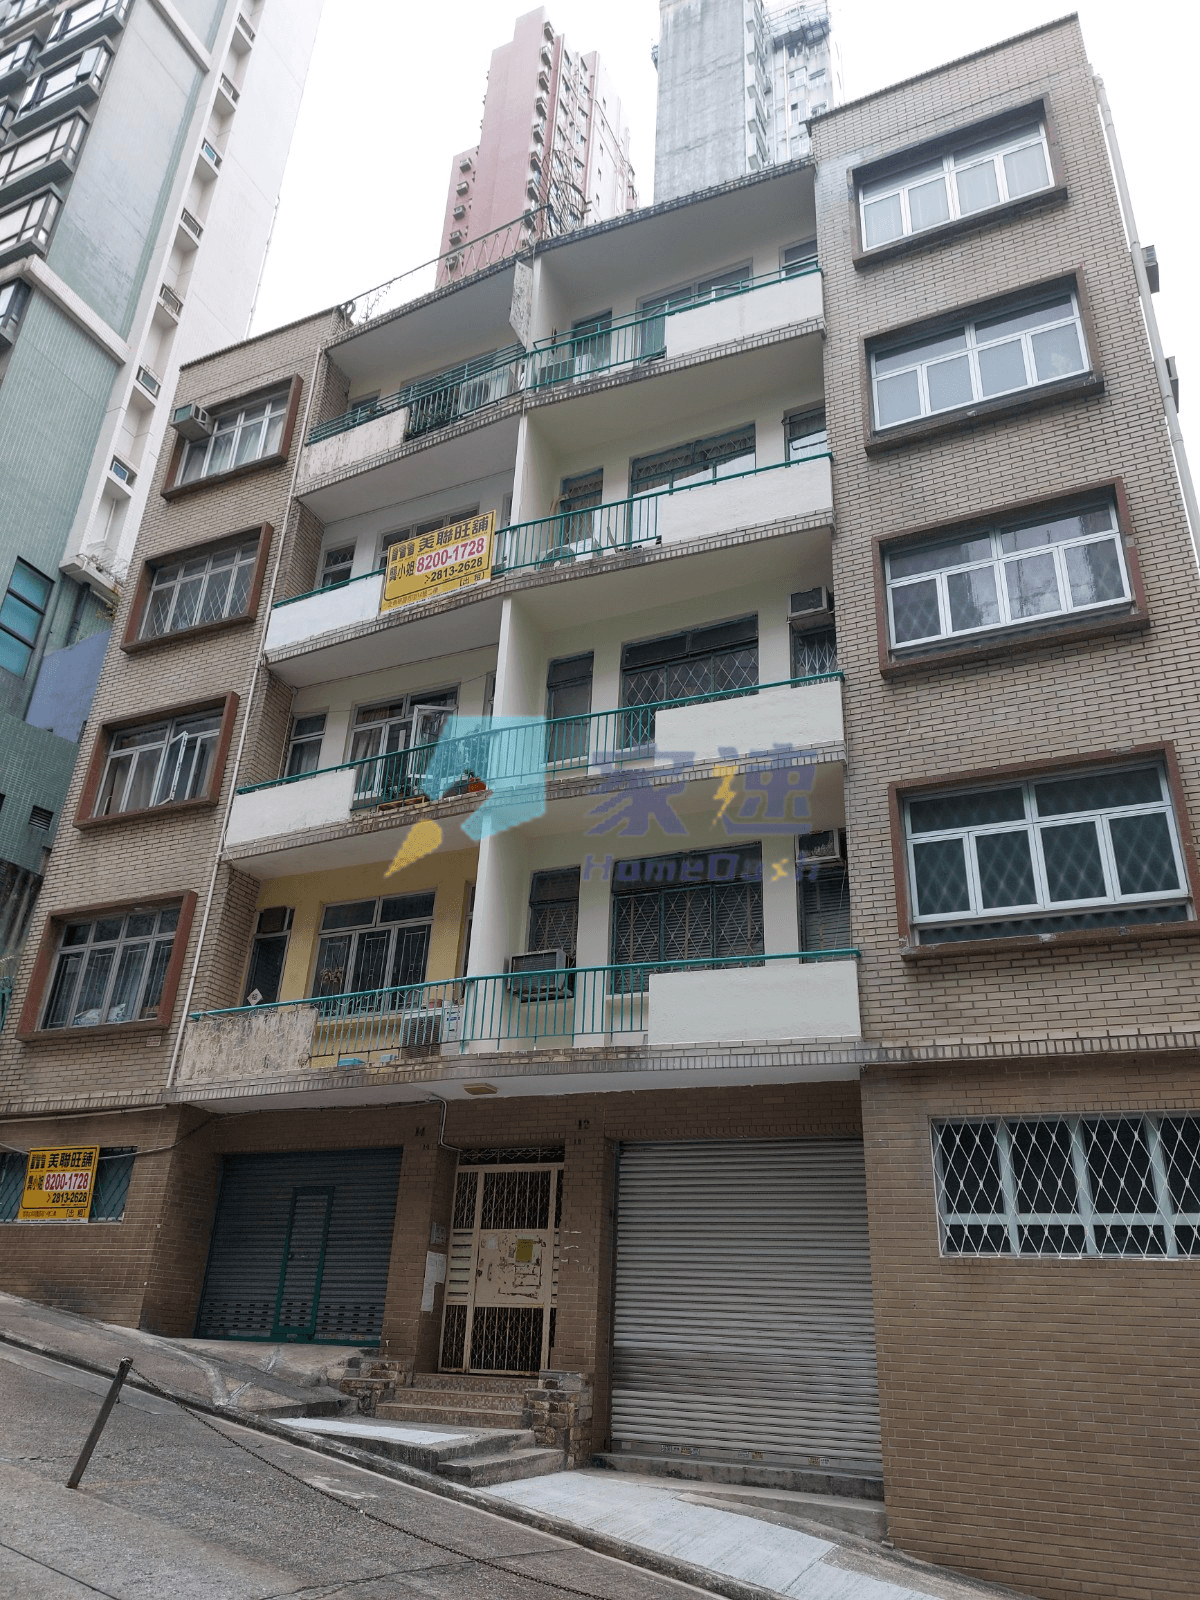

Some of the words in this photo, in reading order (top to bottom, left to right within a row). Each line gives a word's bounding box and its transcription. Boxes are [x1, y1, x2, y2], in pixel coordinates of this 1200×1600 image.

[416, 537, 485, 573] 8200-1728
[430, 557, 483, 582] 2813-2628
[45, 1172, 89, 1190] 8200-1728
[52, 1192, 87, 1203] 2813-2628
